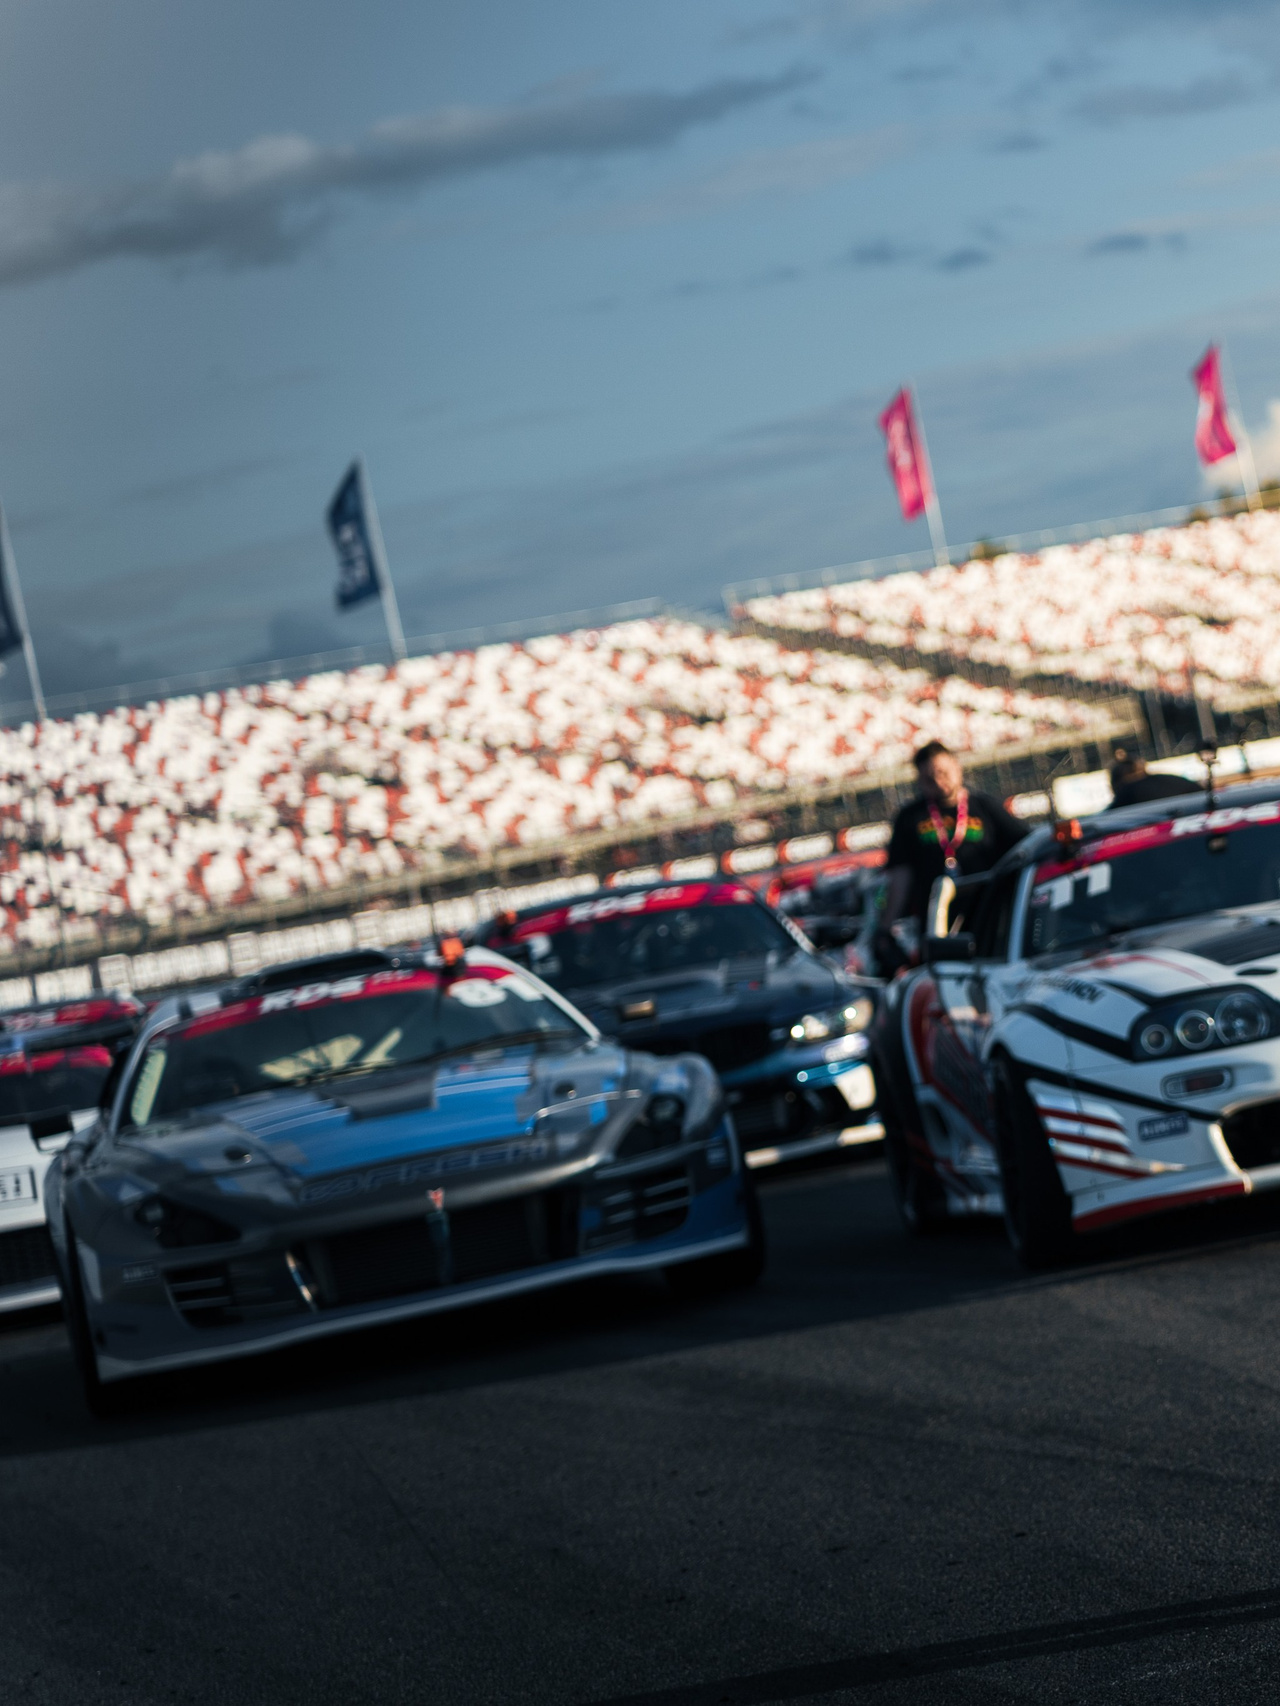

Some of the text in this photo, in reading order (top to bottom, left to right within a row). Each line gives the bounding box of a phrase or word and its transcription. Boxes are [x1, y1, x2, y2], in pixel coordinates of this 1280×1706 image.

[1171, 801, 1280, 837] RDS
[260, 974, 365, 1014] RDS
[448, 975, 544, 1008] 81
